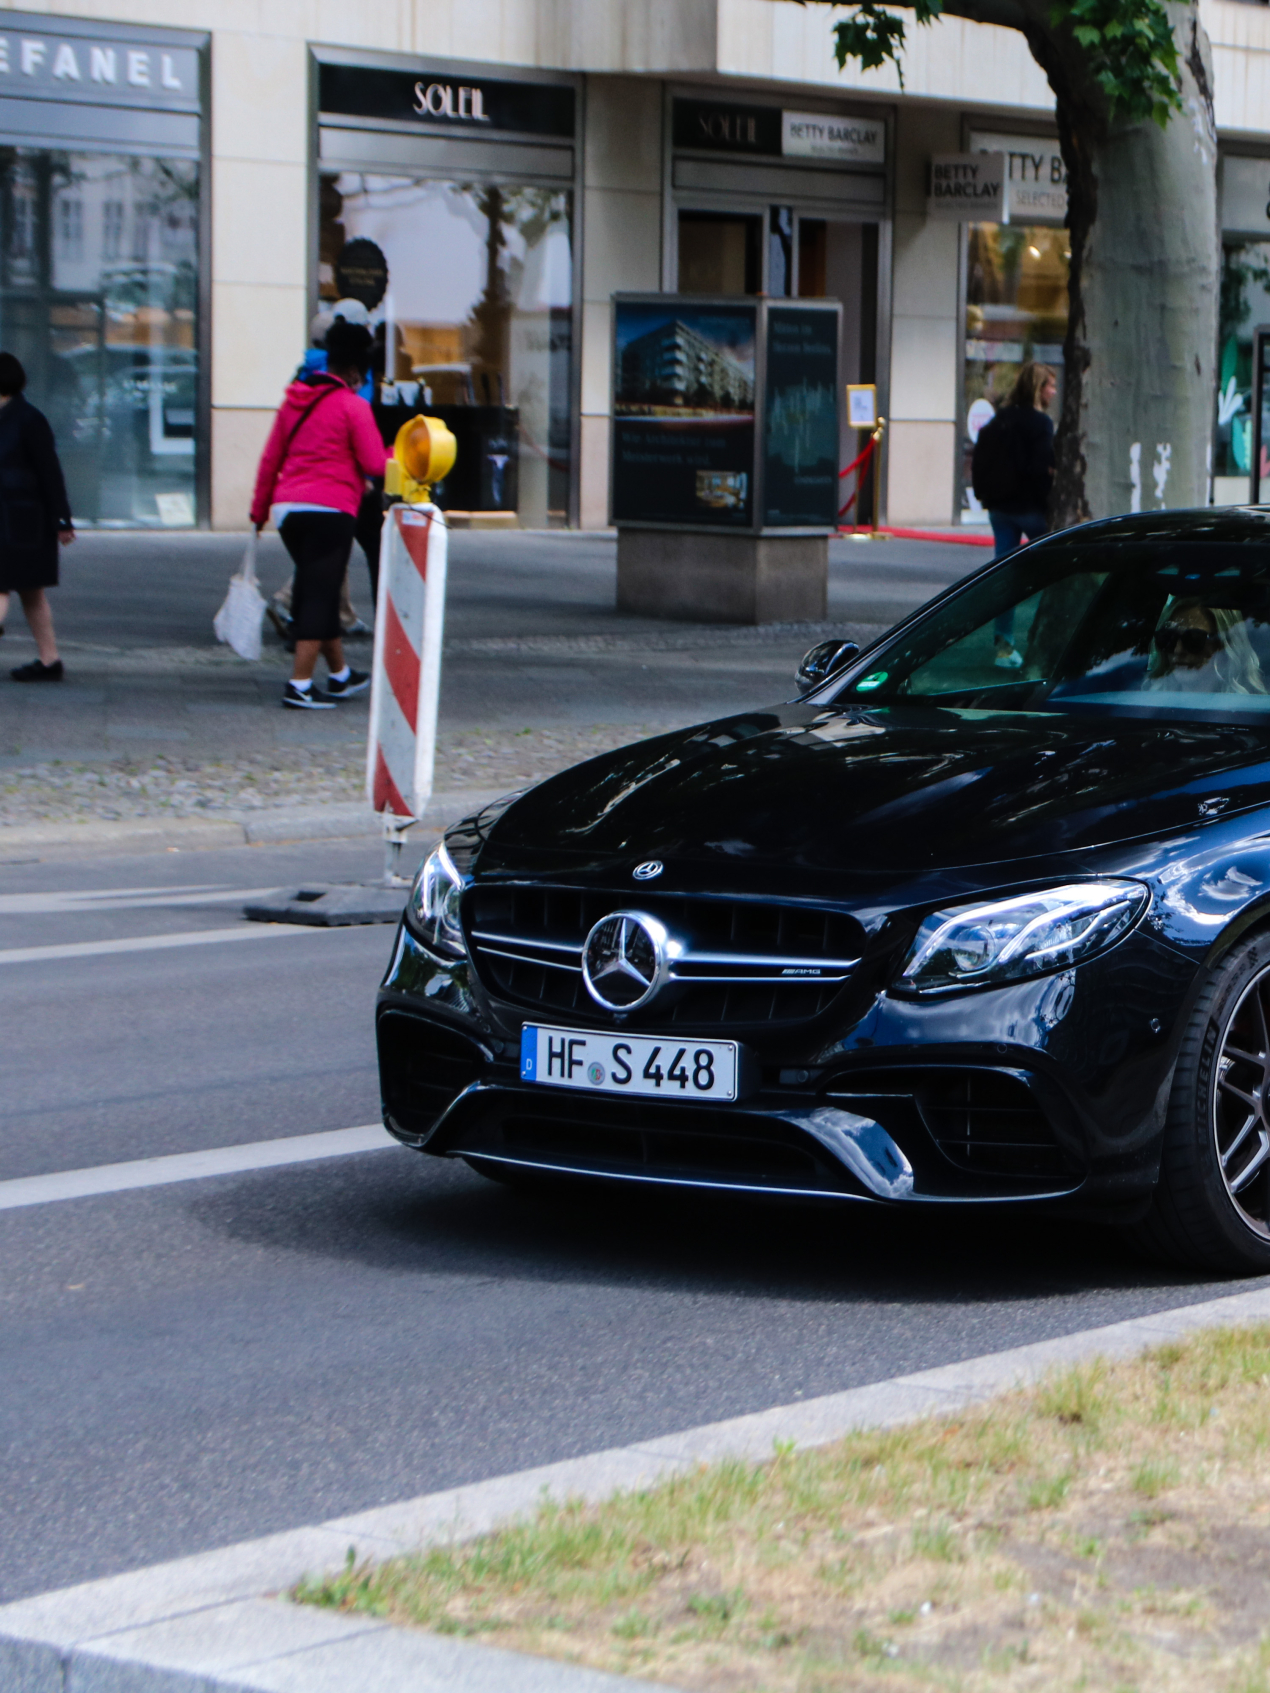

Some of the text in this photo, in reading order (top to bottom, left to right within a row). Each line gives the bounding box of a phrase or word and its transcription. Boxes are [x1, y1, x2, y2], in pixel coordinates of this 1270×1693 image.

[413, 81, 491, 121] SOLEIL
[789, 121, 878, 145] BETTY BARCLAY
[934, 163, 980, 180] BETTY
[933, 181, 1000, 198] BARCLAY
[525, 1058, 533, 1071] D
[547, 1035, 715, 1091] HF S 448
